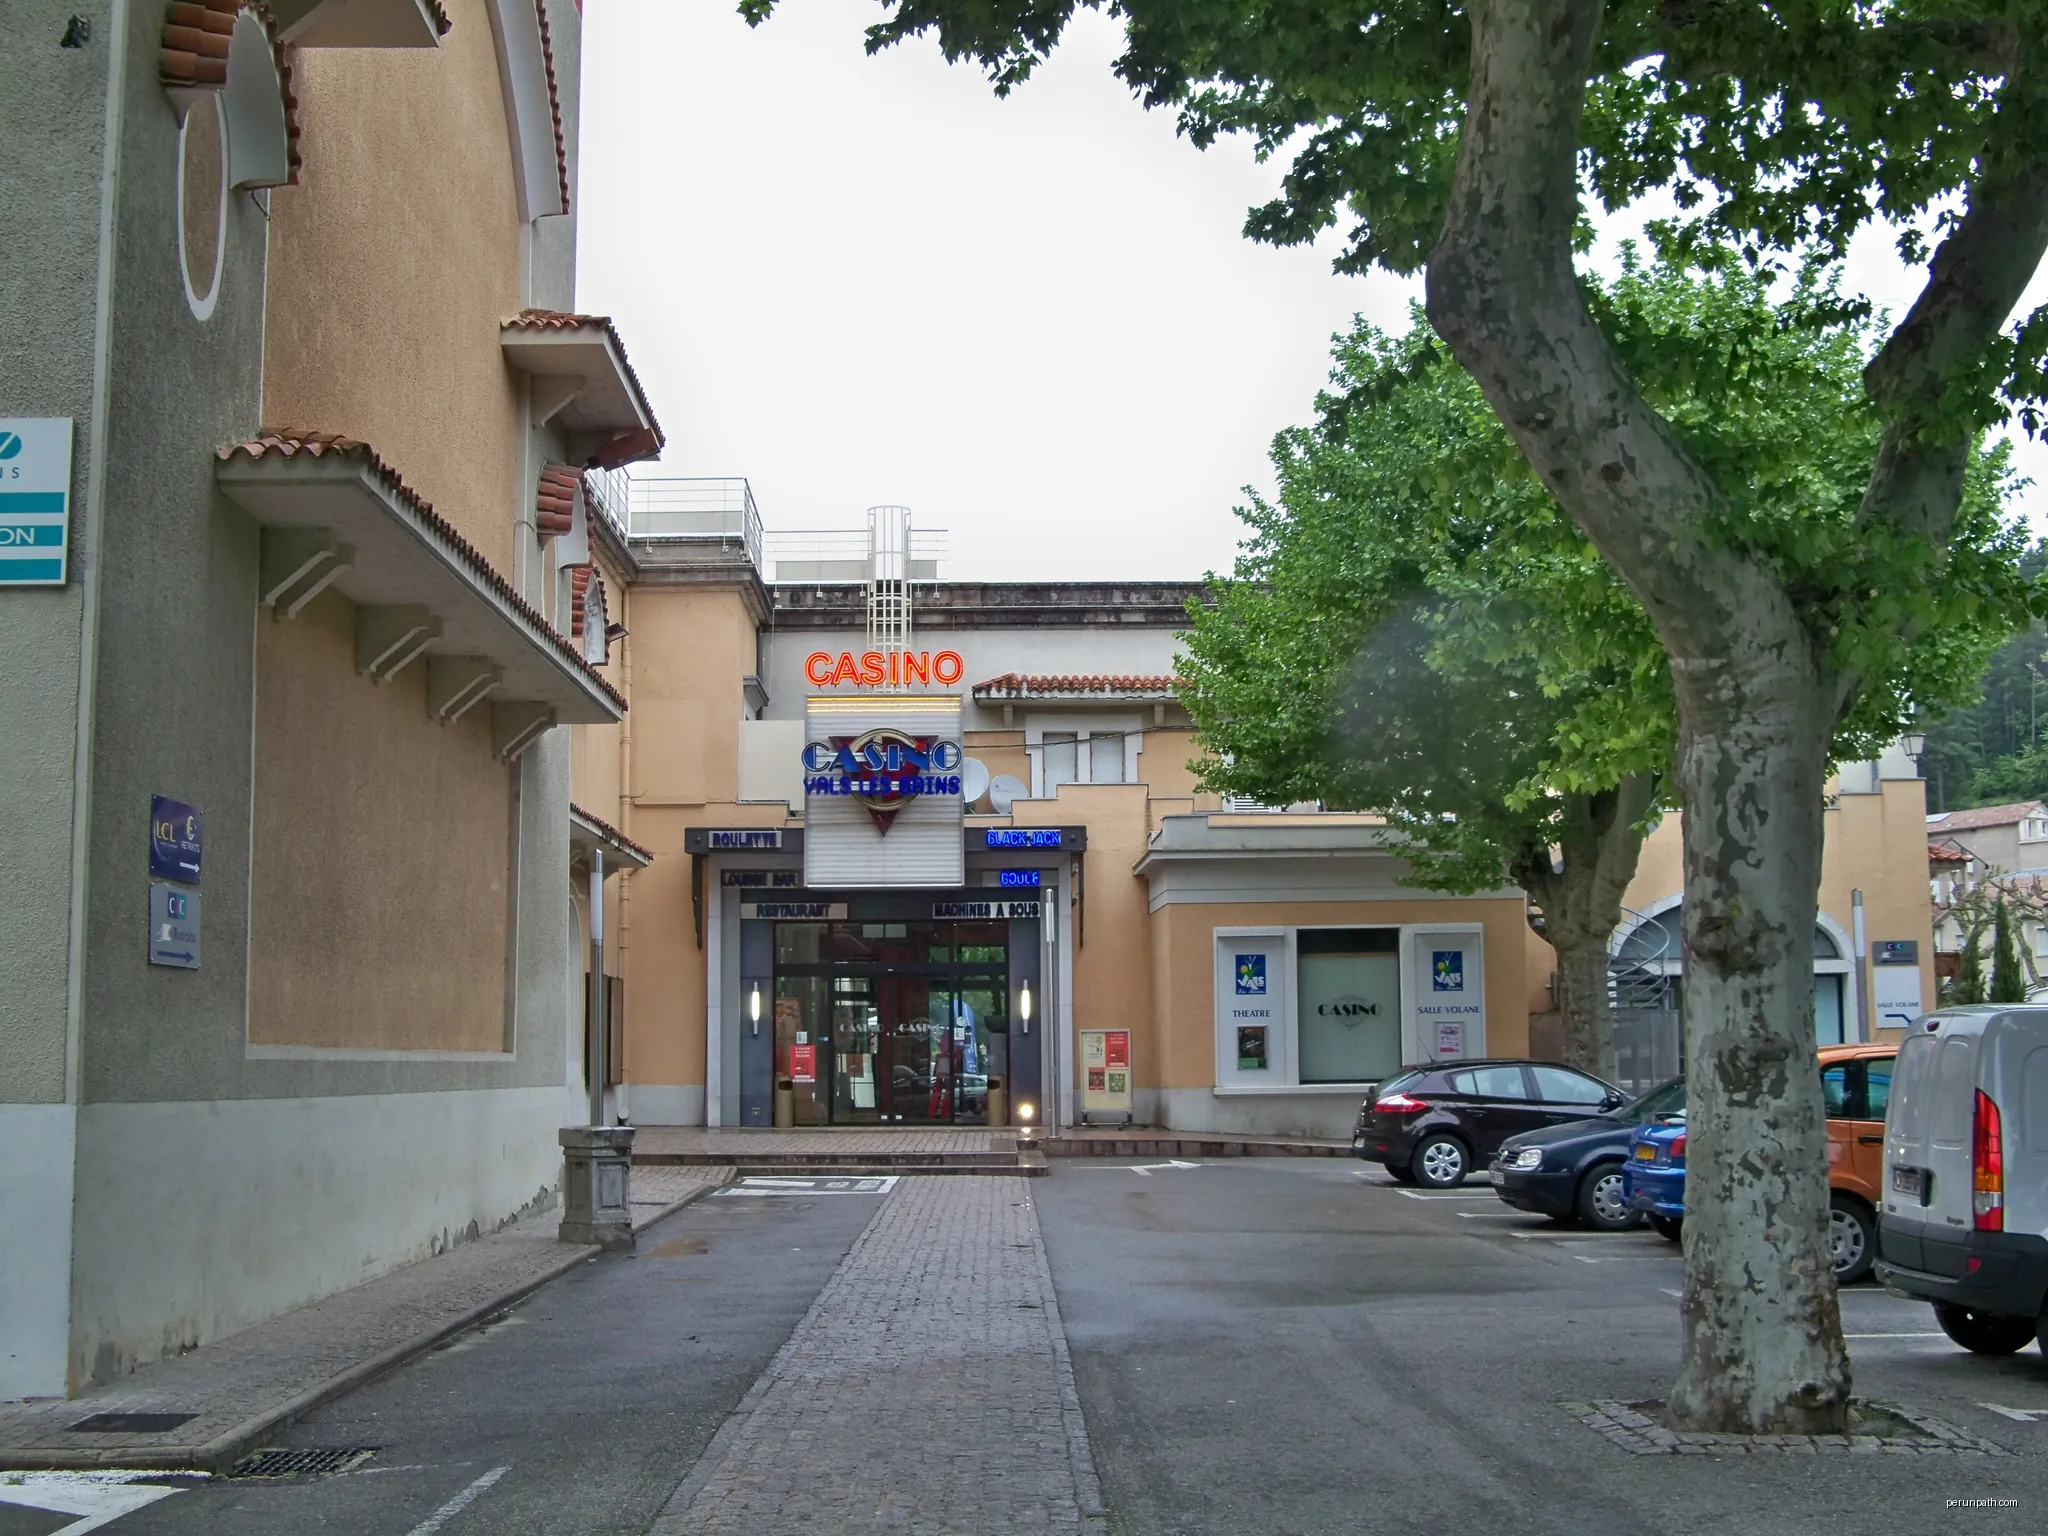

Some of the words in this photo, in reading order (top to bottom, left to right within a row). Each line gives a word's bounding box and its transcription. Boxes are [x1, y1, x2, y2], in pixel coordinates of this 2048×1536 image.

[804, 651, 964, 686] CASINO
[801, 740, 962, 773] CASINO
[803, 776, 852, 796] VALS
[859, 776, 892, 796] LES
[899, 776, 961, 796] BAINS
[156, 820, 177, 843] LCL
[712, 832, 777, 847] ROULETTE
[757, 903, 831, 918] RESTAURANT
[934, 903, 992, 917] MACHINES
[996, 903, 1005, 917] A
[1008, 903, 1039, 917] SOUS
[1232, 1009, 1271, 1018] THEATRE
[1317, 1003, 1383, 1017] CASINO
[1418, 1006, 1442, 1015] SALLE
[1445, 1005, 1480, 1014] VOLANE
